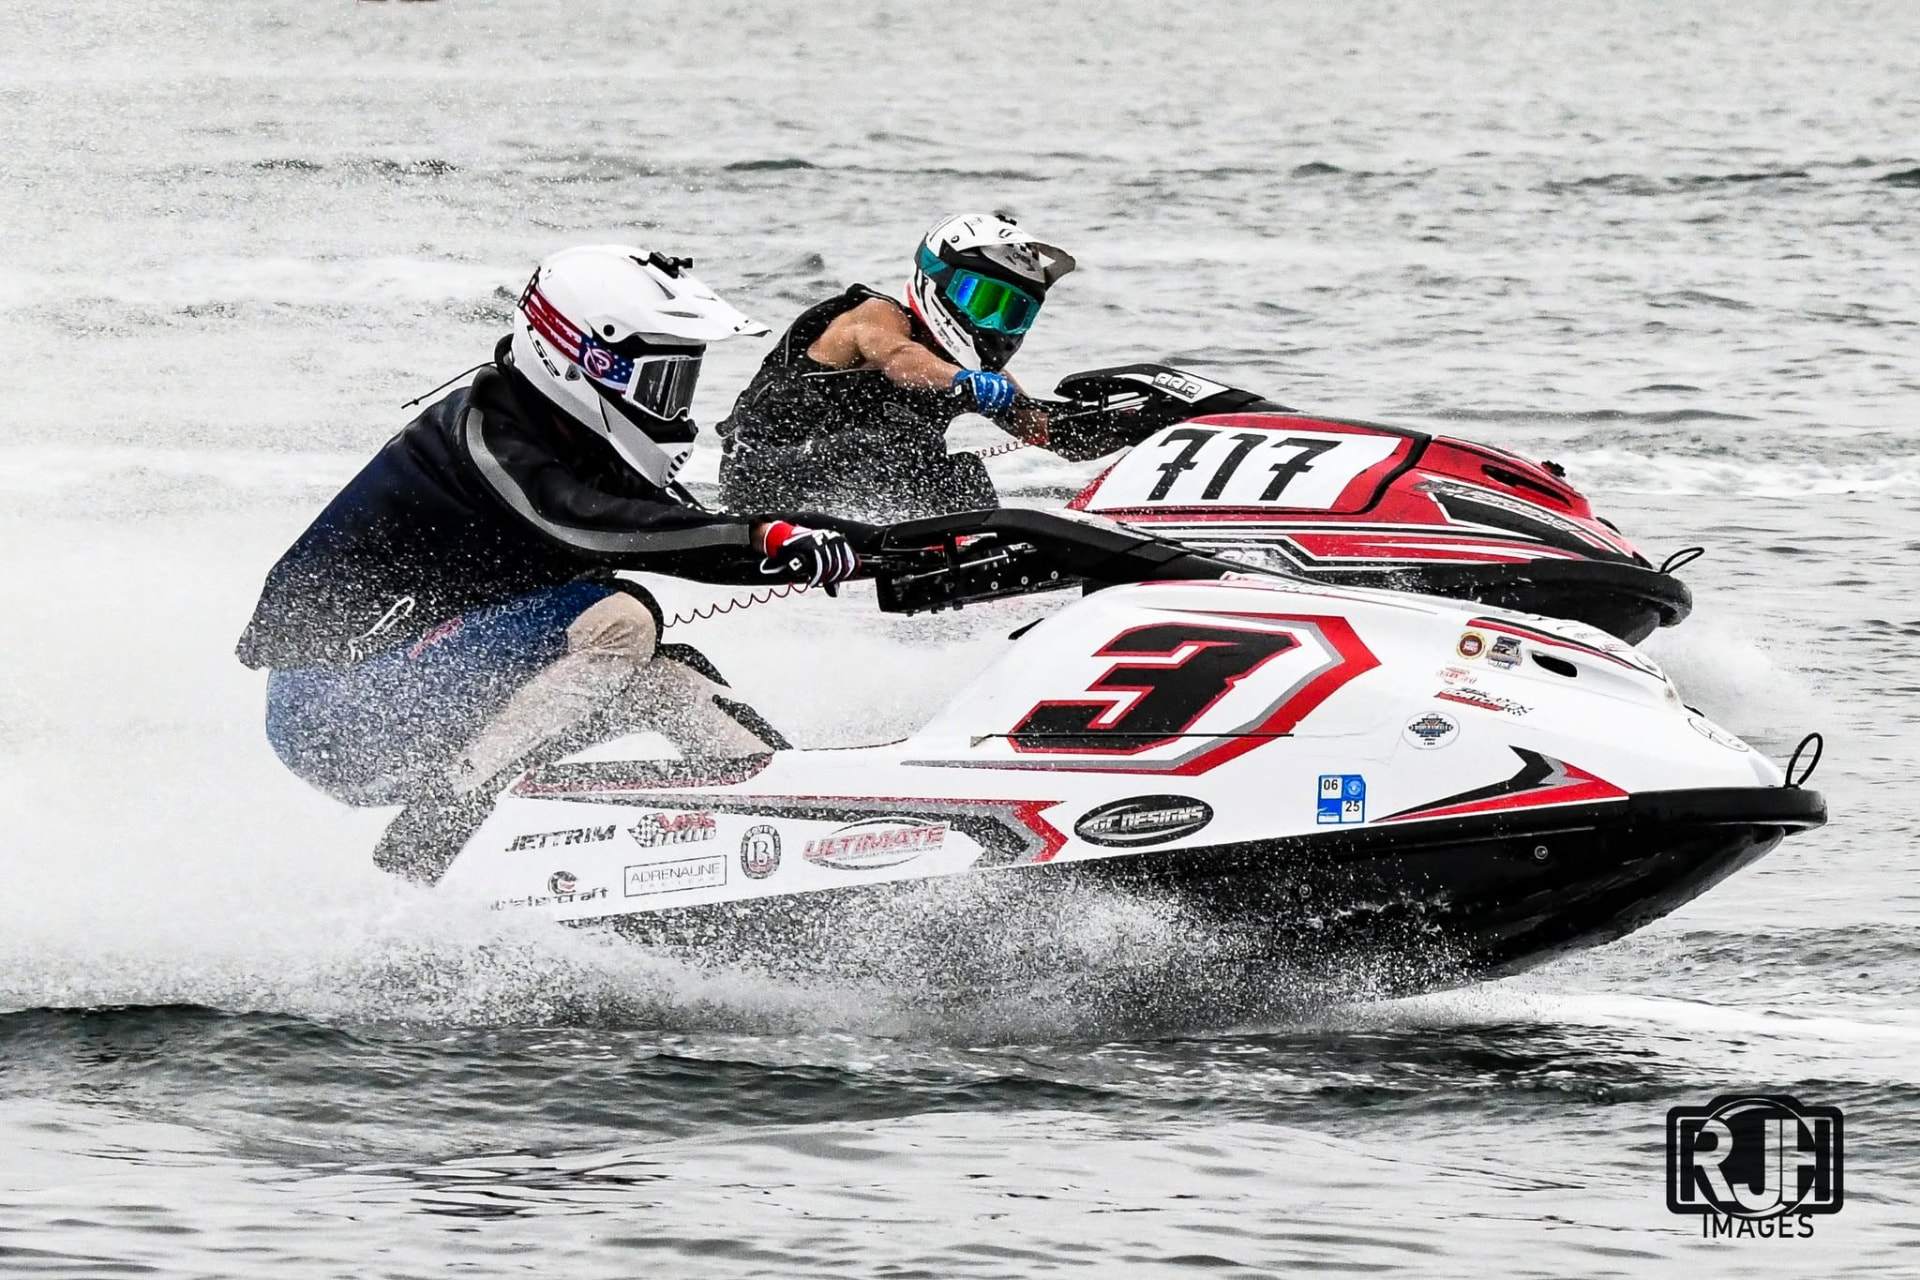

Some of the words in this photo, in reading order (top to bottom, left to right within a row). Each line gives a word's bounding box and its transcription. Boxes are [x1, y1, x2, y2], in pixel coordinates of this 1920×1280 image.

[1146, 428, 1340, 502] 717
[1007, 622, 1302, 756] 3
[1323, 779, 1338, 791] 06
[1120, 805, 1205, 831] DESIGNS
[1345, 800, 1360, 812] 25
[802, 824, 946, 860] ULTIMATE
[630, 862, 721, 884] ADRENALINE
